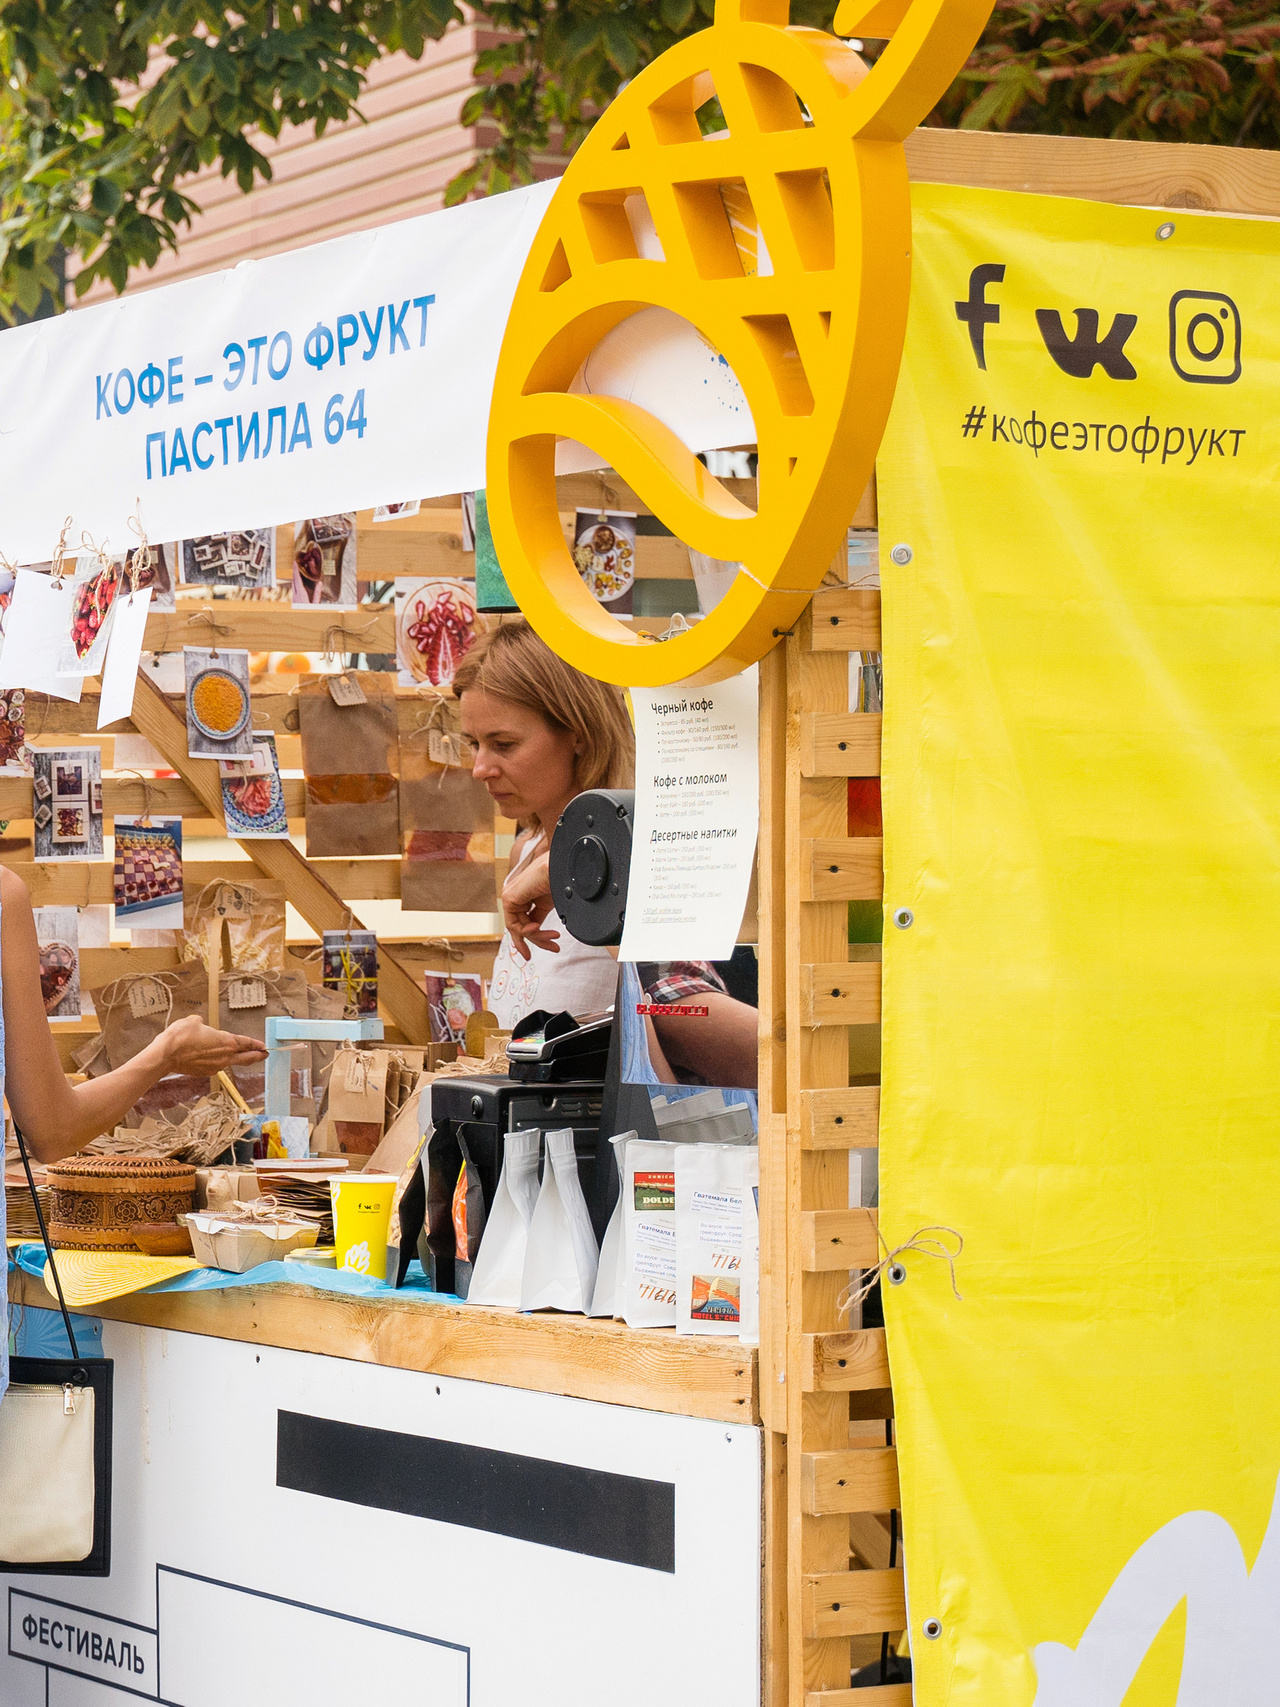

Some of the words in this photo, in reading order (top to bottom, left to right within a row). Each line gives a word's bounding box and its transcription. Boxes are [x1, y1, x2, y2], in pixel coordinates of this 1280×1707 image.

[95, 356, 184, 421] КОФЕ
[222, 331, 293, 392] ЭТО
[303, 294, 436, 371] ФРУКТ
[144, 401, 313, 480] ПАСТИЛА
[322, 388, 368, 445] 64
[961, 405, 1246, 466] #кофеэтофрукт
[651, 698, 688, 717] Черный
[690, 697, 714, 713] кофе
[653, 774, 677, 790] Кофе
[678, 776, 684, 786] с
[685, 773, 728, 785] молоком
[650, 829, 698, 845] Десертные
[700, 828, 738, 840] напитки
[21, 1613, 145, 1675] ФЕСТИВАЛЬ
